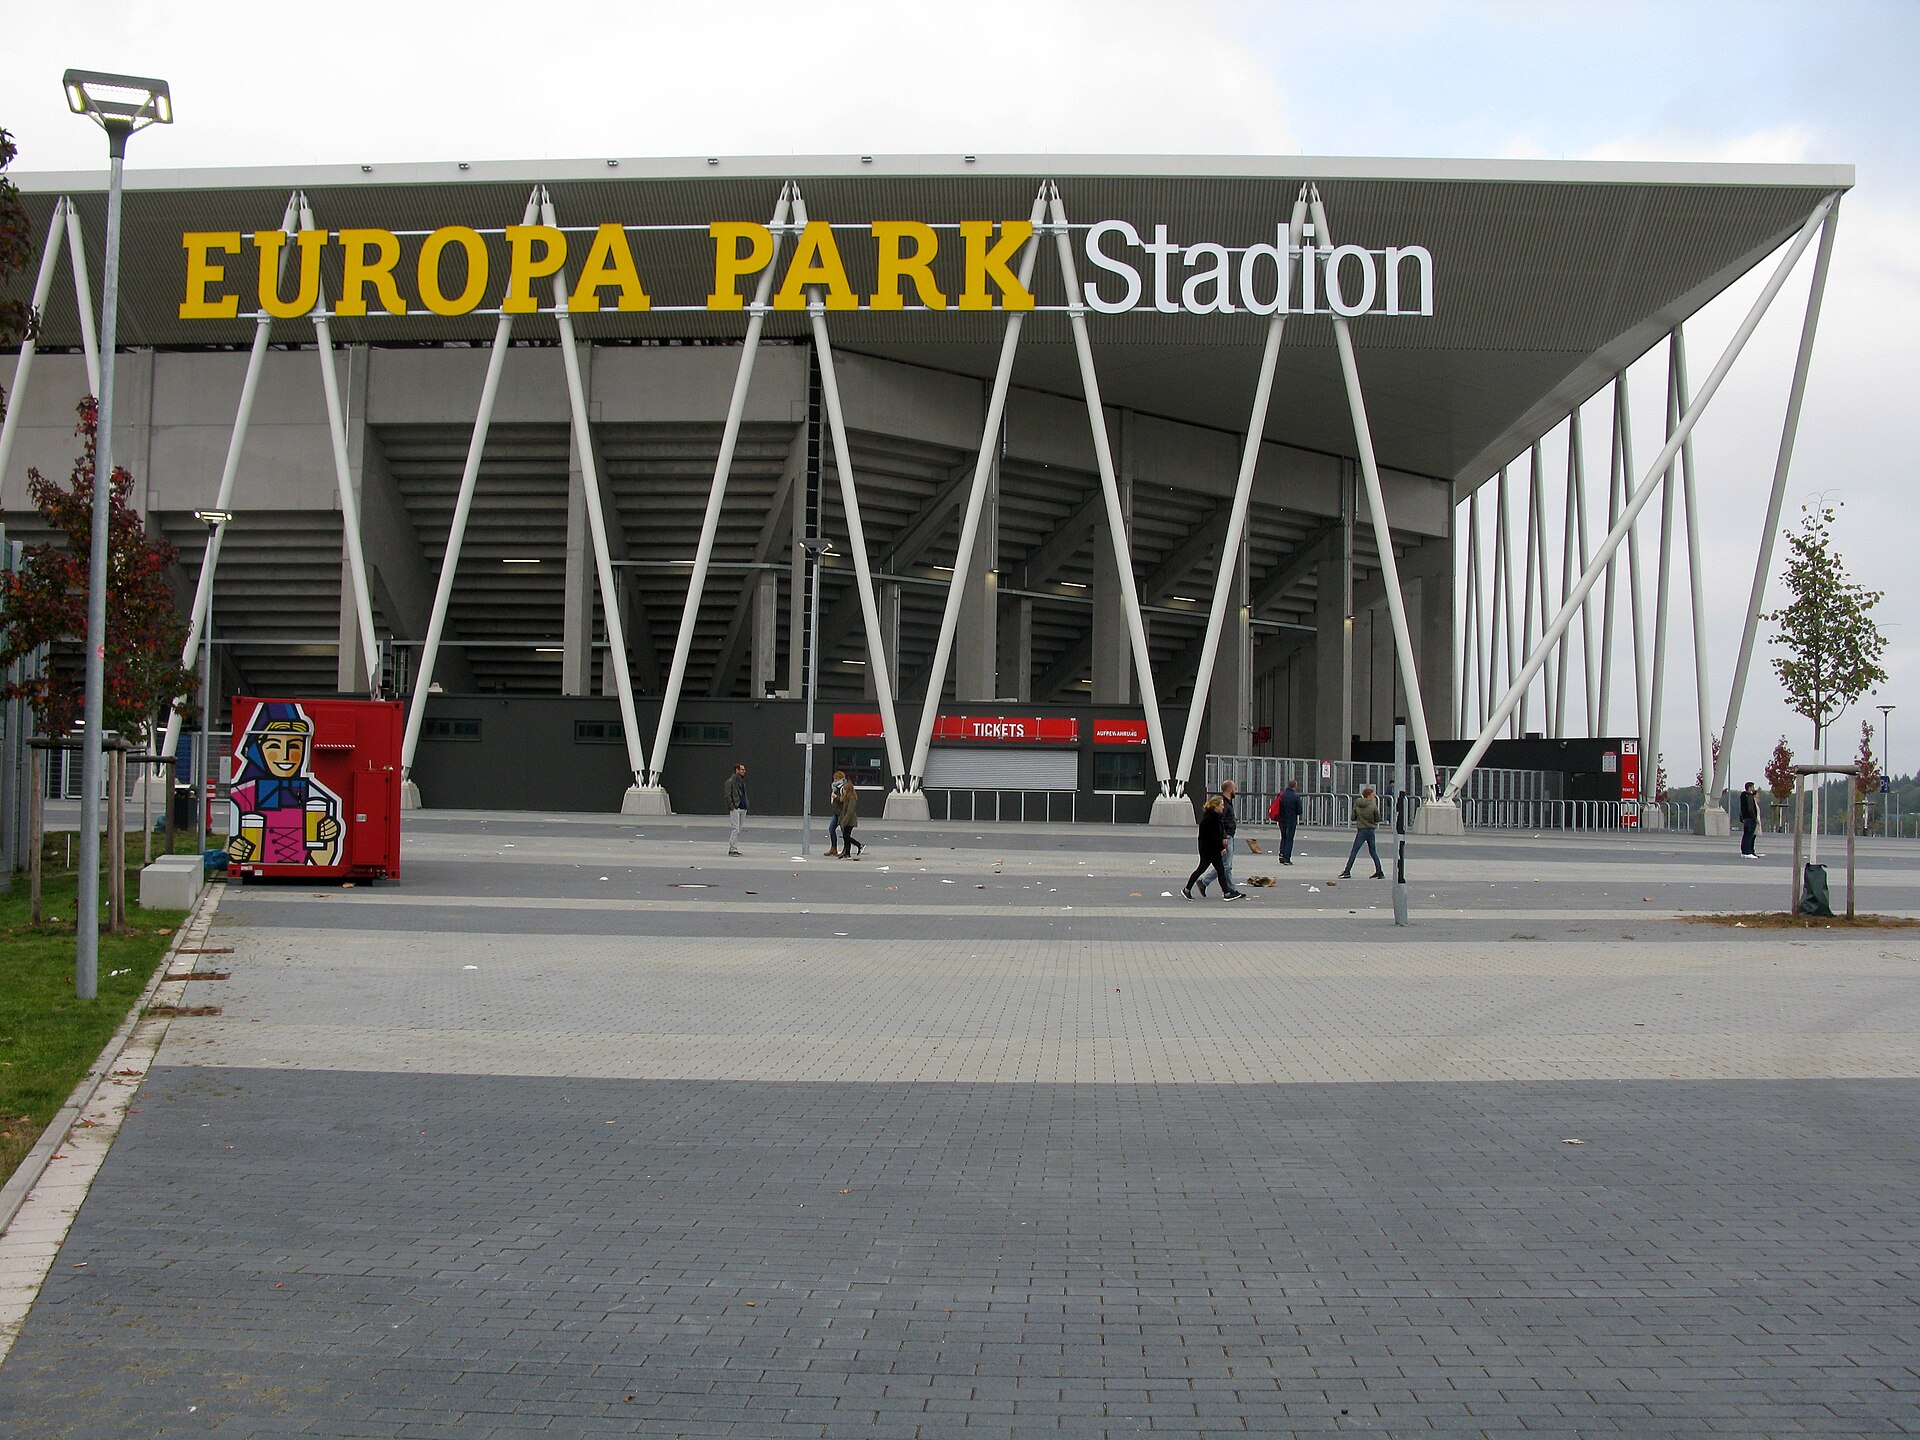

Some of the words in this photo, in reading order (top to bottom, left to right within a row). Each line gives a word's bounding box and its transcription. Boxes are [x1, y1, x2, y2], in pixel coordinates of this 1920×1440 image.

[178, 223, 651, 319] EUROPA
[706, 220, 1036, 312] PARK
[1084, 219, 1434, 317] Stadion
[973, 723, 1025, 738] TICKETS
[1624, 743, 1635, 753] E1
